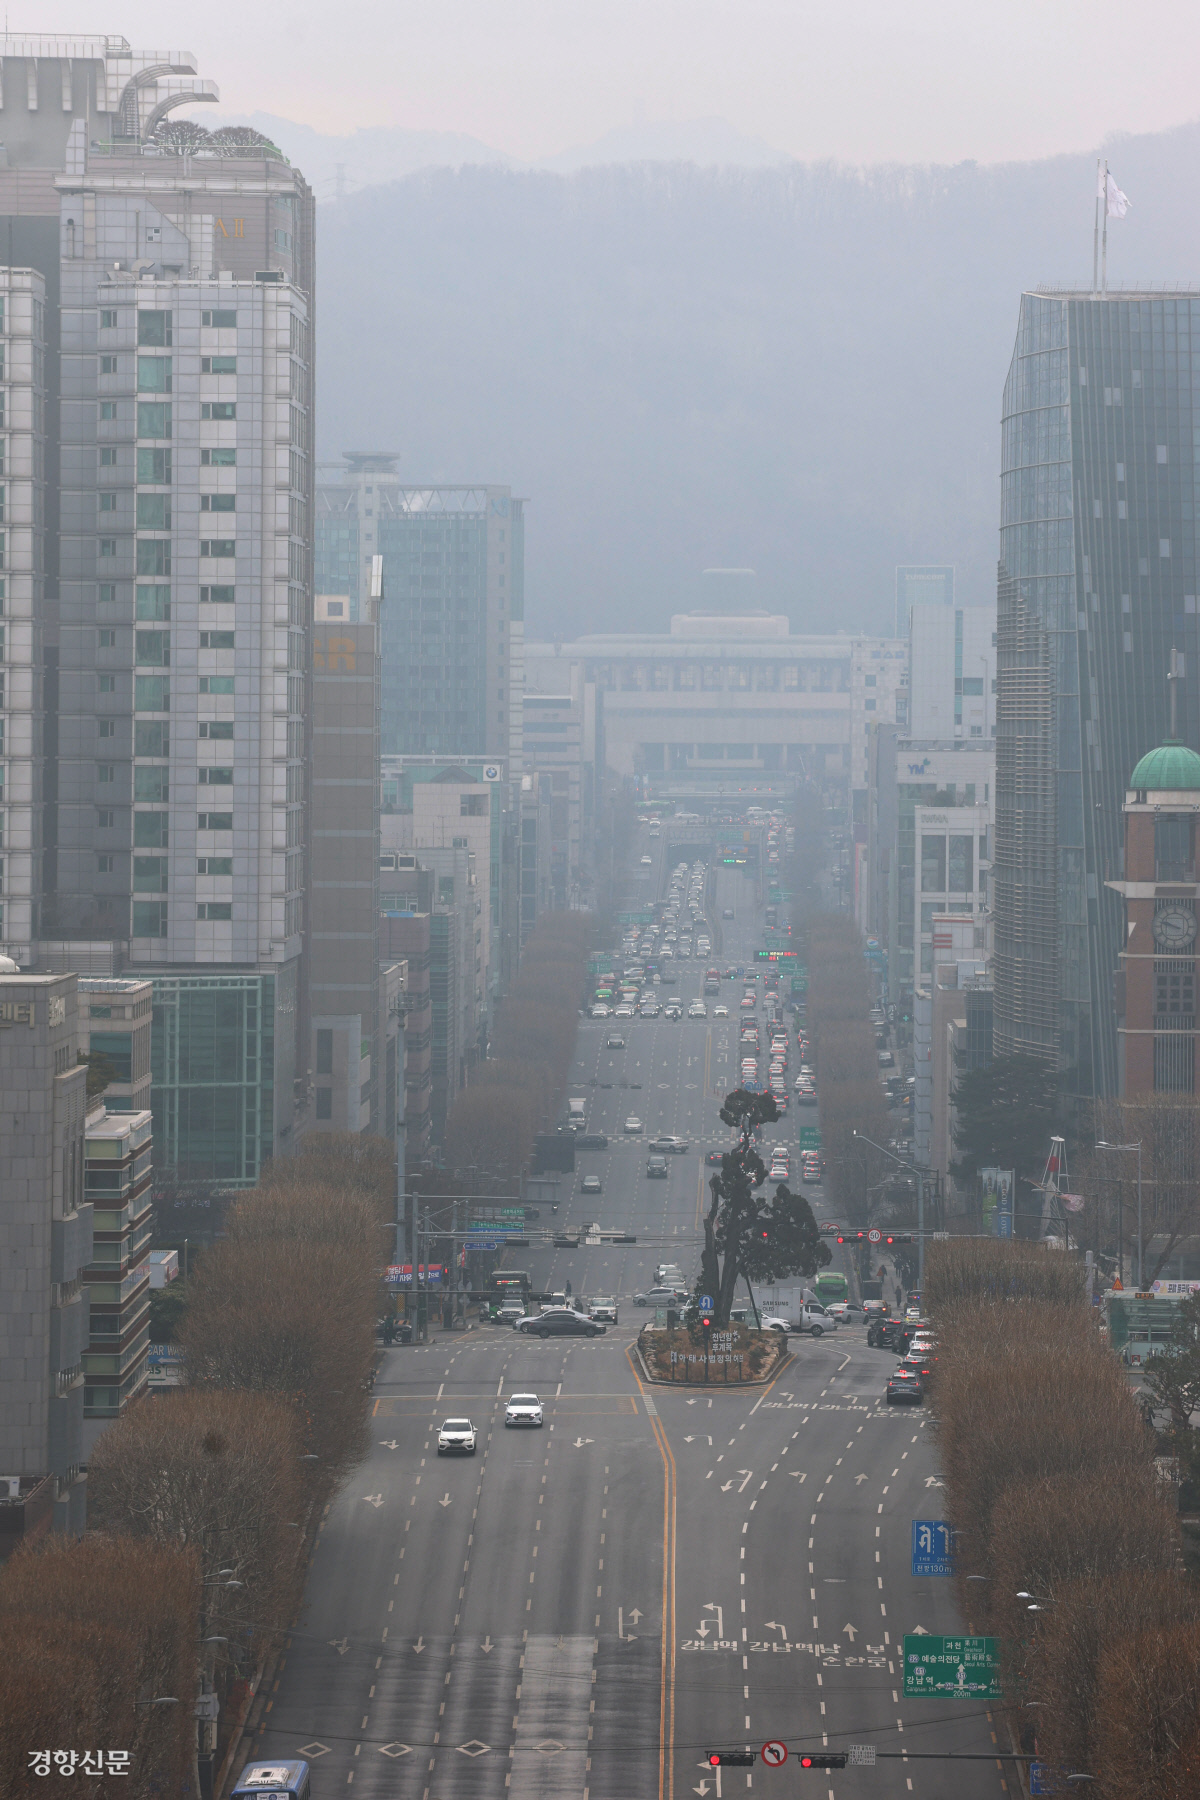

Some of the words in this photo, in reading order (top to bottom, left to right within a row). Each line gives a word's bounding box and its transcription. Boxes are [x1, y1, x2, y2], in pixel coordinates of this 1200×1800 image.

[870, 1232, 879, 1240] 50
[681, 1640, 738, 1652] 강남역
[749, 1641, 813, 1653] 강남역
[946, 1641, 962, 1650] 과천
[922, 1654, 960, 1664] 예술의전당
[906, 1676, 934, 1685] 강남역
